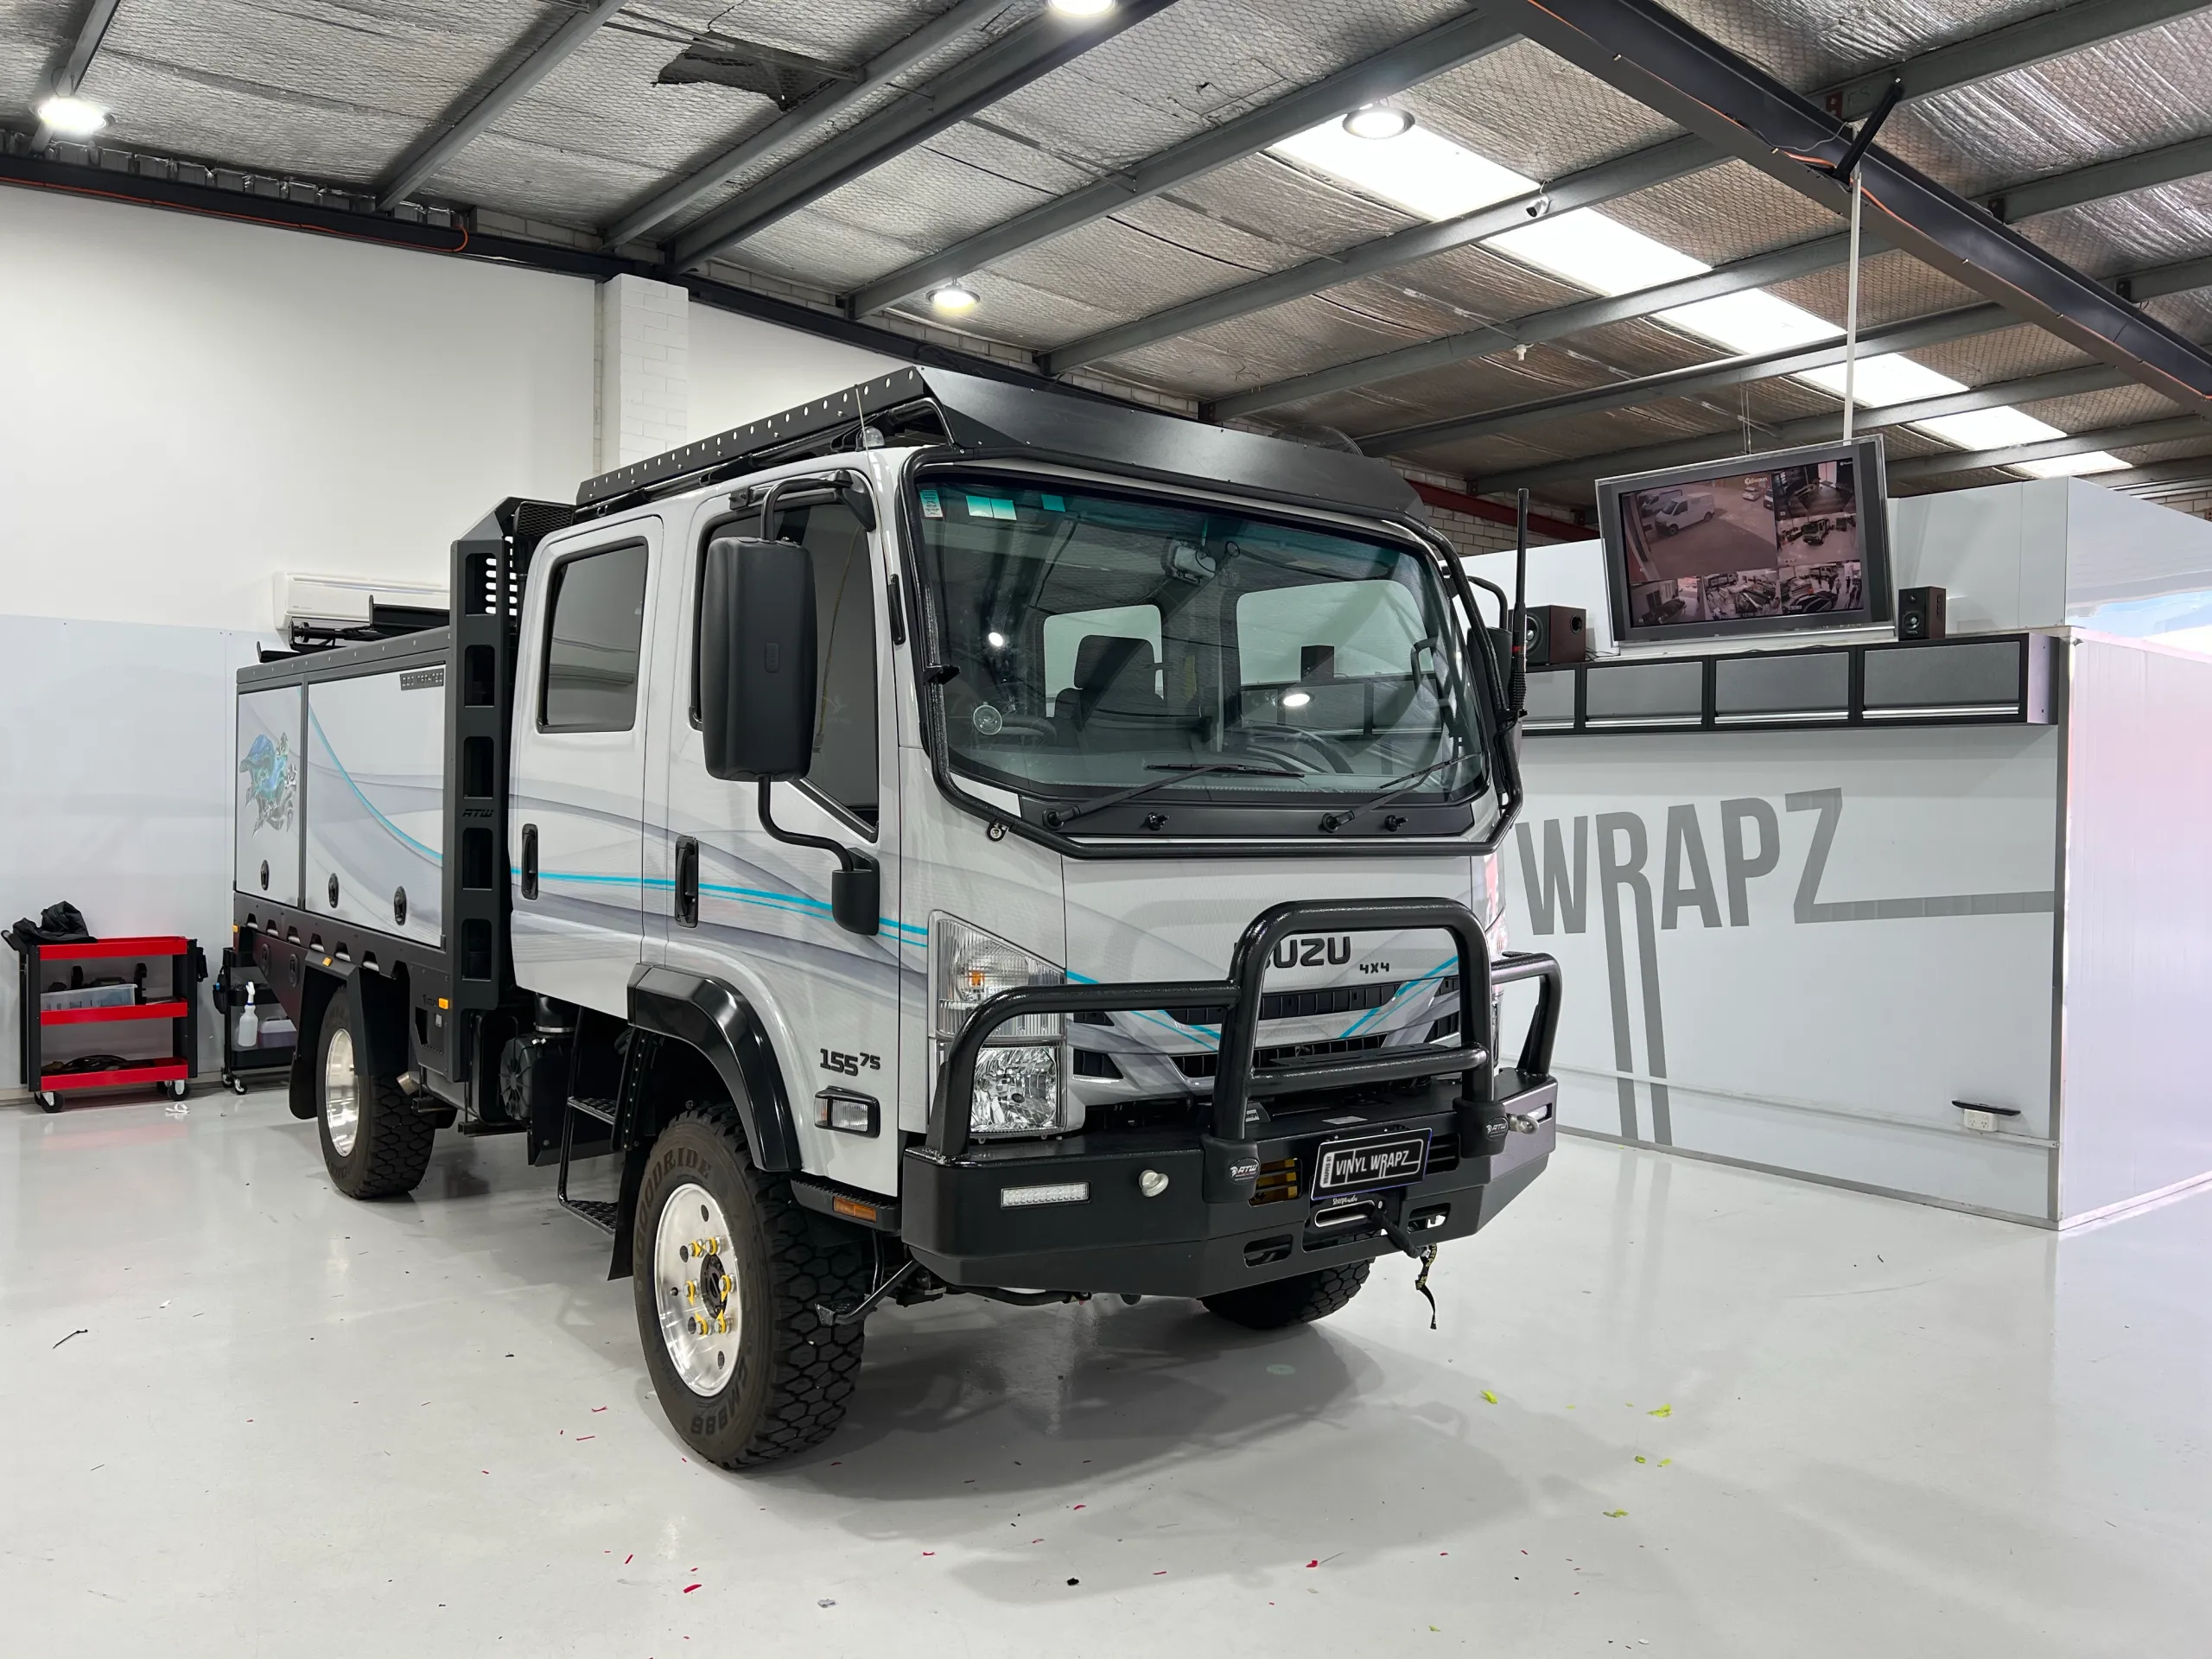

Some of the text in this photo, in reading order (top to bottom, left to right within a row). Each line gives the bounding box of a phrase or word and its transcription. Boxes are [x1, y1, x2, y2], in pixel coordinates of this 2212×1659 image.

[462, 809, 494, 817] ATW
[1234, 936, 1351, 969] UZU
[1238, 1164, 1258, 1173] ATW
[1336, 1150, 1414, 1179] VINYL WRAPZ
[637, 1147, 712, 1258] GOODRIDE
